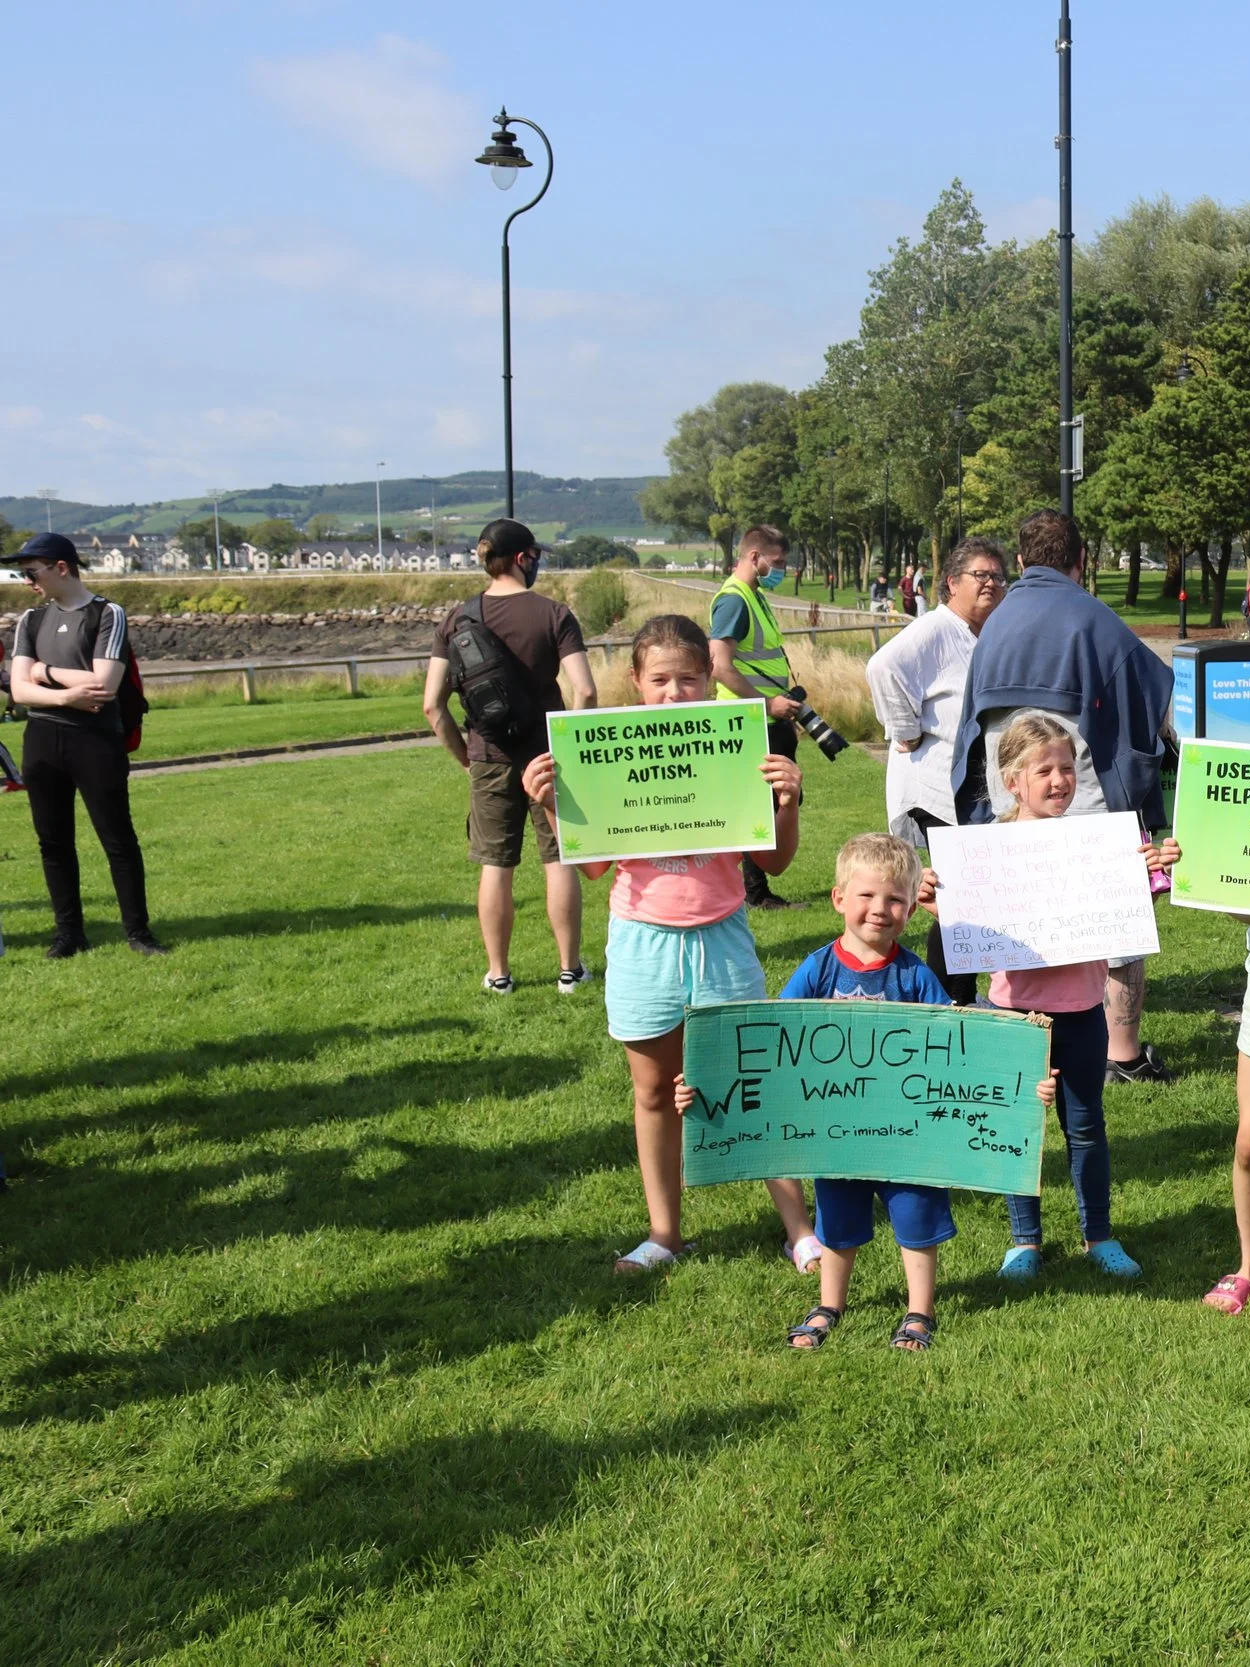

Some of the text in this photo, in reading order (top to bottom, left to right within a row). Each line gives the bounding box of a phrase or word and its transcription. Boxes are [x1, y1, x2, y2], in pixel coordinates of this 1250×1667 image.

[1213, 680, 1235, 688] Love
[1213, 691, 1240, 699] Leave
[575, 716, 744, 743] I USE CANNABIS. IT
[580, 746, 634, 765] HELPS
[639, 744, 664, 761] ME
[669, 740, 715, 758] WITH
[627, 764, 697, 783] AUTISM.
[1206, 761, 1212, 777] I
[1217, 762, 1250, 780] USE
[1161, 779, 1177, 791] Els
[624, 793, 696, 808] Am I A Criminal?
[613, 826, 633, 834] Dont
[650, 823, 672, 833] High,
[679, 821, 693, 829] Get
[694, 819, 726, 830] Healthy
[1225, 876, 1247, 886] Dont
[953, 927, 971, 941] EU
[952, 942, 974, 954] CBD
[977, 941, 1005, 953] WAS
[1011, 937, 1039, 949] NOT
[735, 1020, 967, 1074] ENOUGH!
[694, 1072, 1022, 1120] WE WANT CHANGE!
[827, 1119, 919, 1139] Criminalise!
[977, 1124, 997, 1138] to
[968, 1138, 1029, 1157] Choose!
